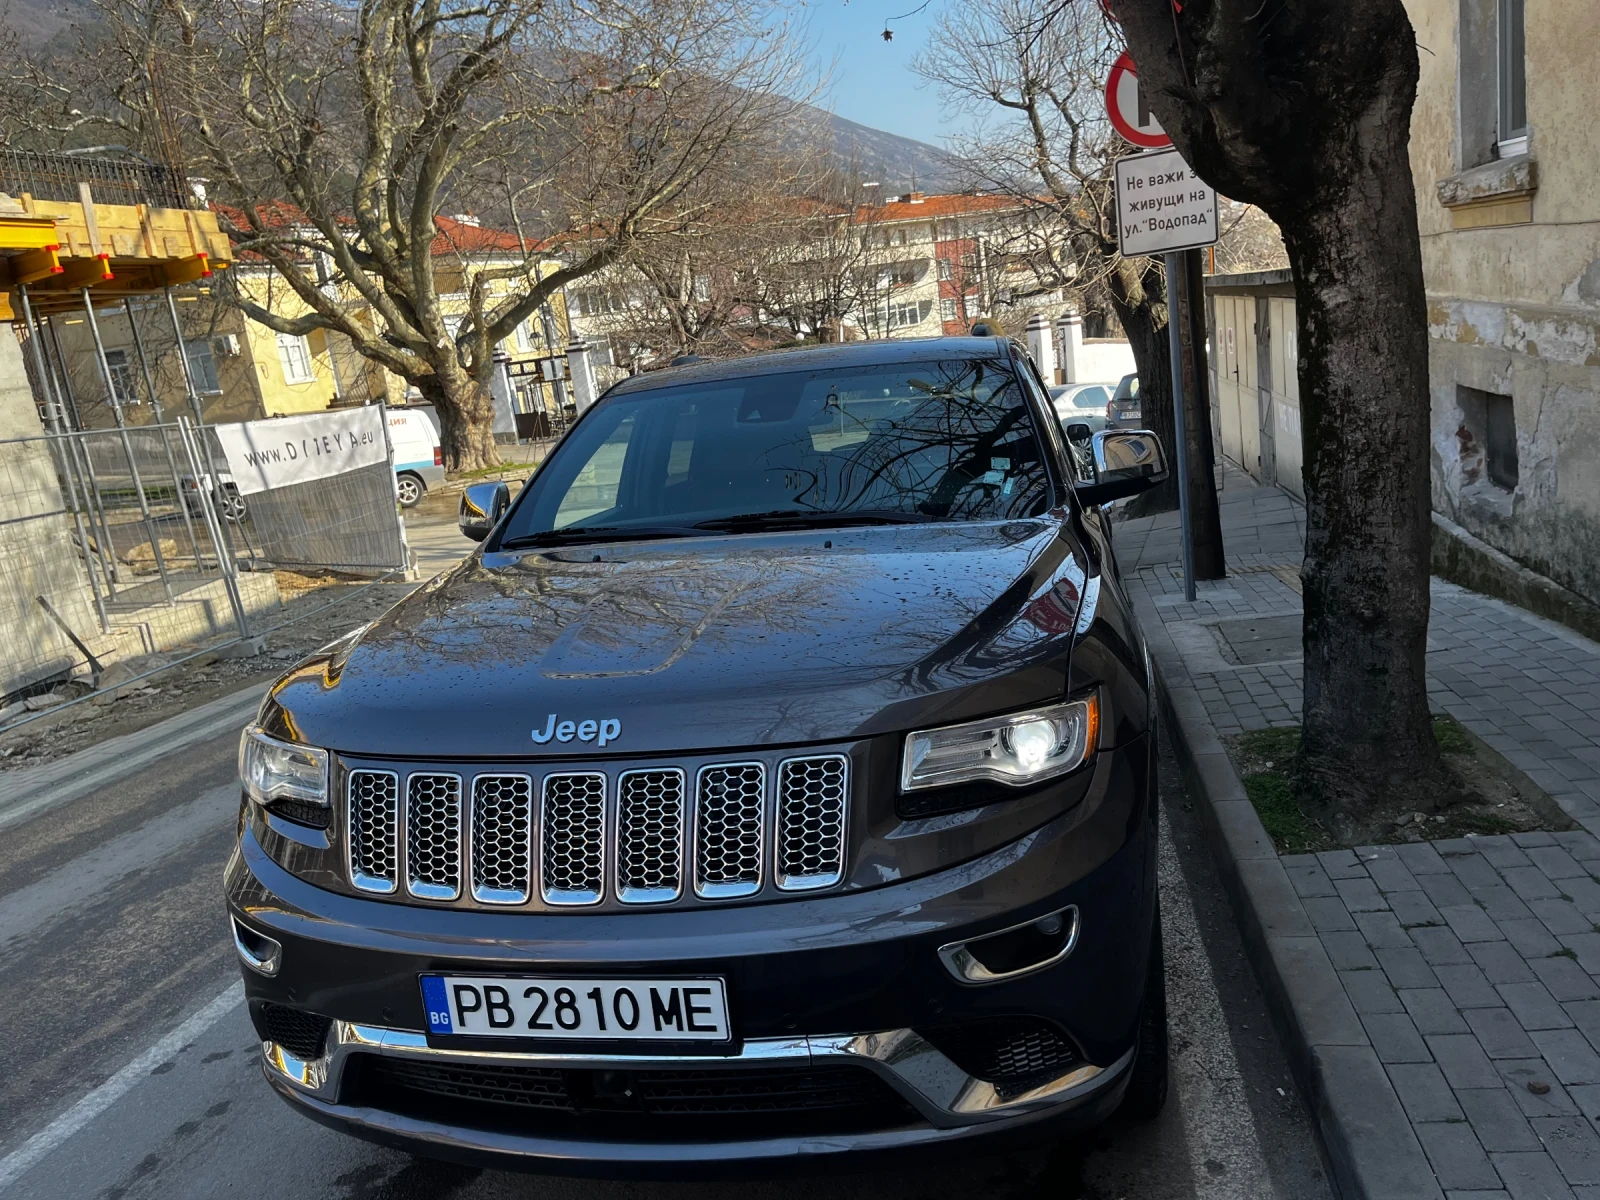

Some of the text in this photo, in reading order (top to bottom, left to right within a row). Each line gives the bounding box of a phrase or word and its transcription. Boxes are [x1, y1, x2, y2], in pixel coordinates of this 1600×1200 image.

[1127, 177, 1144, 191] Не
[1148, 171, 1184, 187] важи
[1129, 189, 1206, 212] живущи на
[531, 713, 622, 748] Jeep
[430, 1011, 449, 1025] BG
[453, 984, 718, 1032] PB 2810 ME
